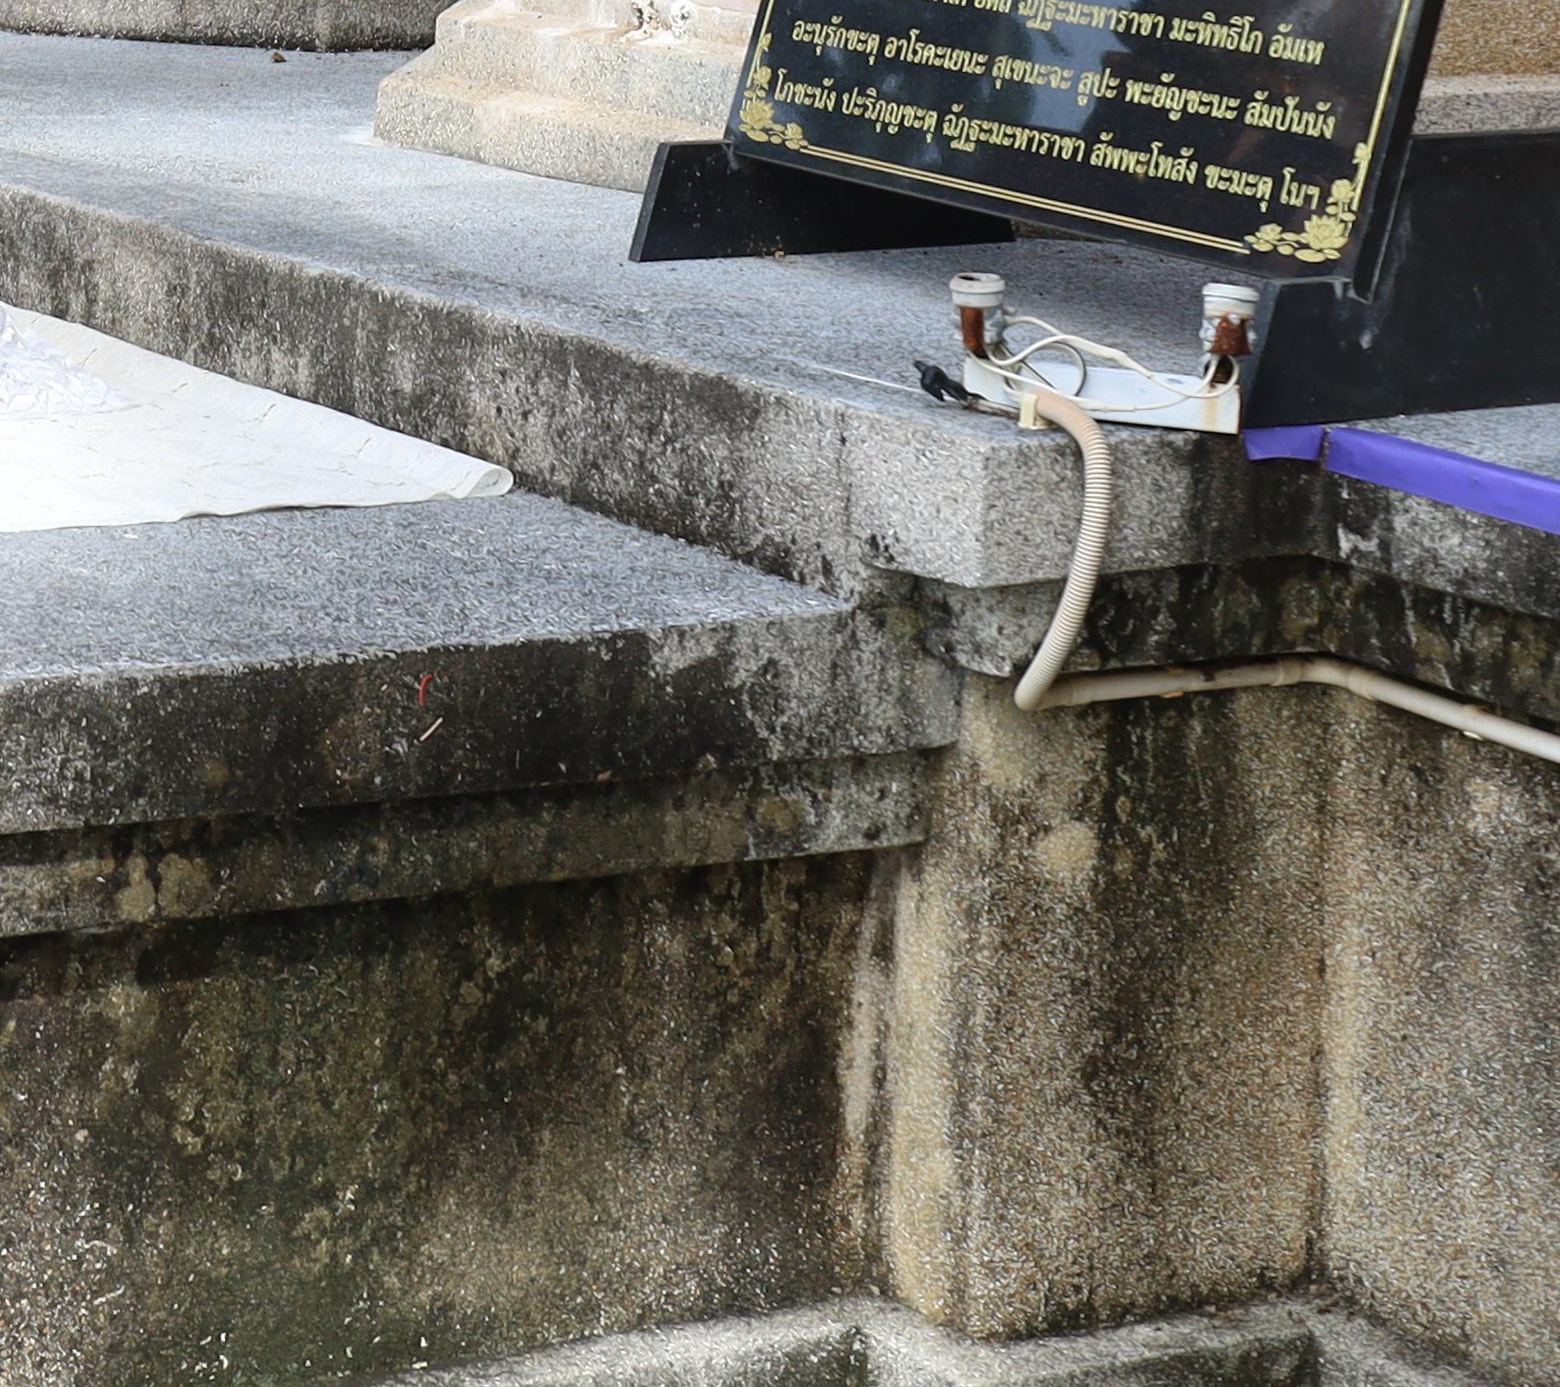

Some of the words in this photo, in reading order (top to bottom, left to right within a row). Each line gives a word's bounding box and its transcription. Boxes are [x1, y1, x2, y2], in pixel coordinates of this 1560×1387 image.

[791, 15, 880, 65] อะนุรักขะตุ
[884, 29, 989, 75] อาโรคะเยนะ
[1077, 68, 1120, 107] สูปะ
[1124, 72, 1241, 121] พะยัญชะนะ
[1243, 90, 1337, 140] สัมปันนัง
[1168, 11, 1264, 55] มะหิทธิโก
[1267, 23, 1325, 65] อัมเห
[773, 67, 837, 112] โภชะนัง
[1089, 131, 1200, 185] สัพพะโทสัง
[1204, 163, 1274, 213] ขะมะตุ
[1278, 166, 1321, 210] โนฯ
